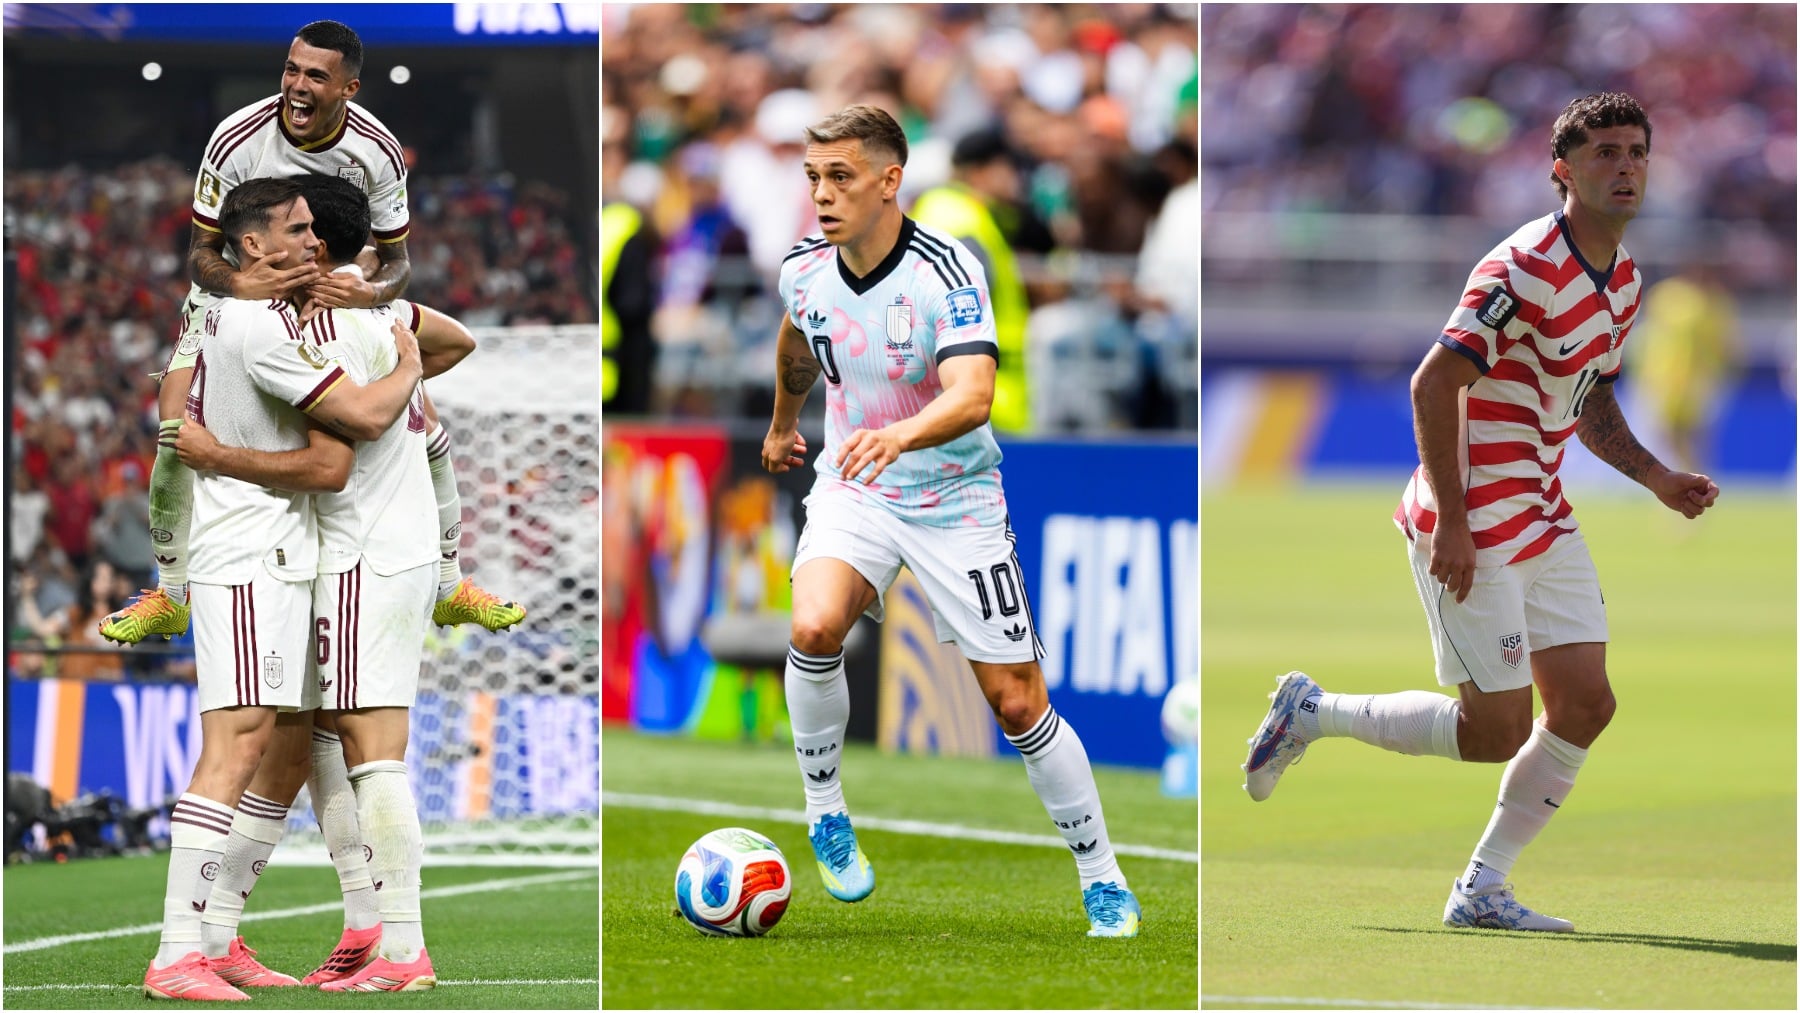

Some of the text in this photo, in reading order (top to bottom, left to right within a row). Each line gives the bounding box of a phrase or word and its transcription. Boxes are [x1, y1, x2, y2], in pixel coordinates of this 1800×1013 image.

[967, 562, 1020, 621] 10
[1039, 514, 1167, 696] FIFA
[315, 616, 331, 666] 6
[1501, 634, 1521, 649] USA
